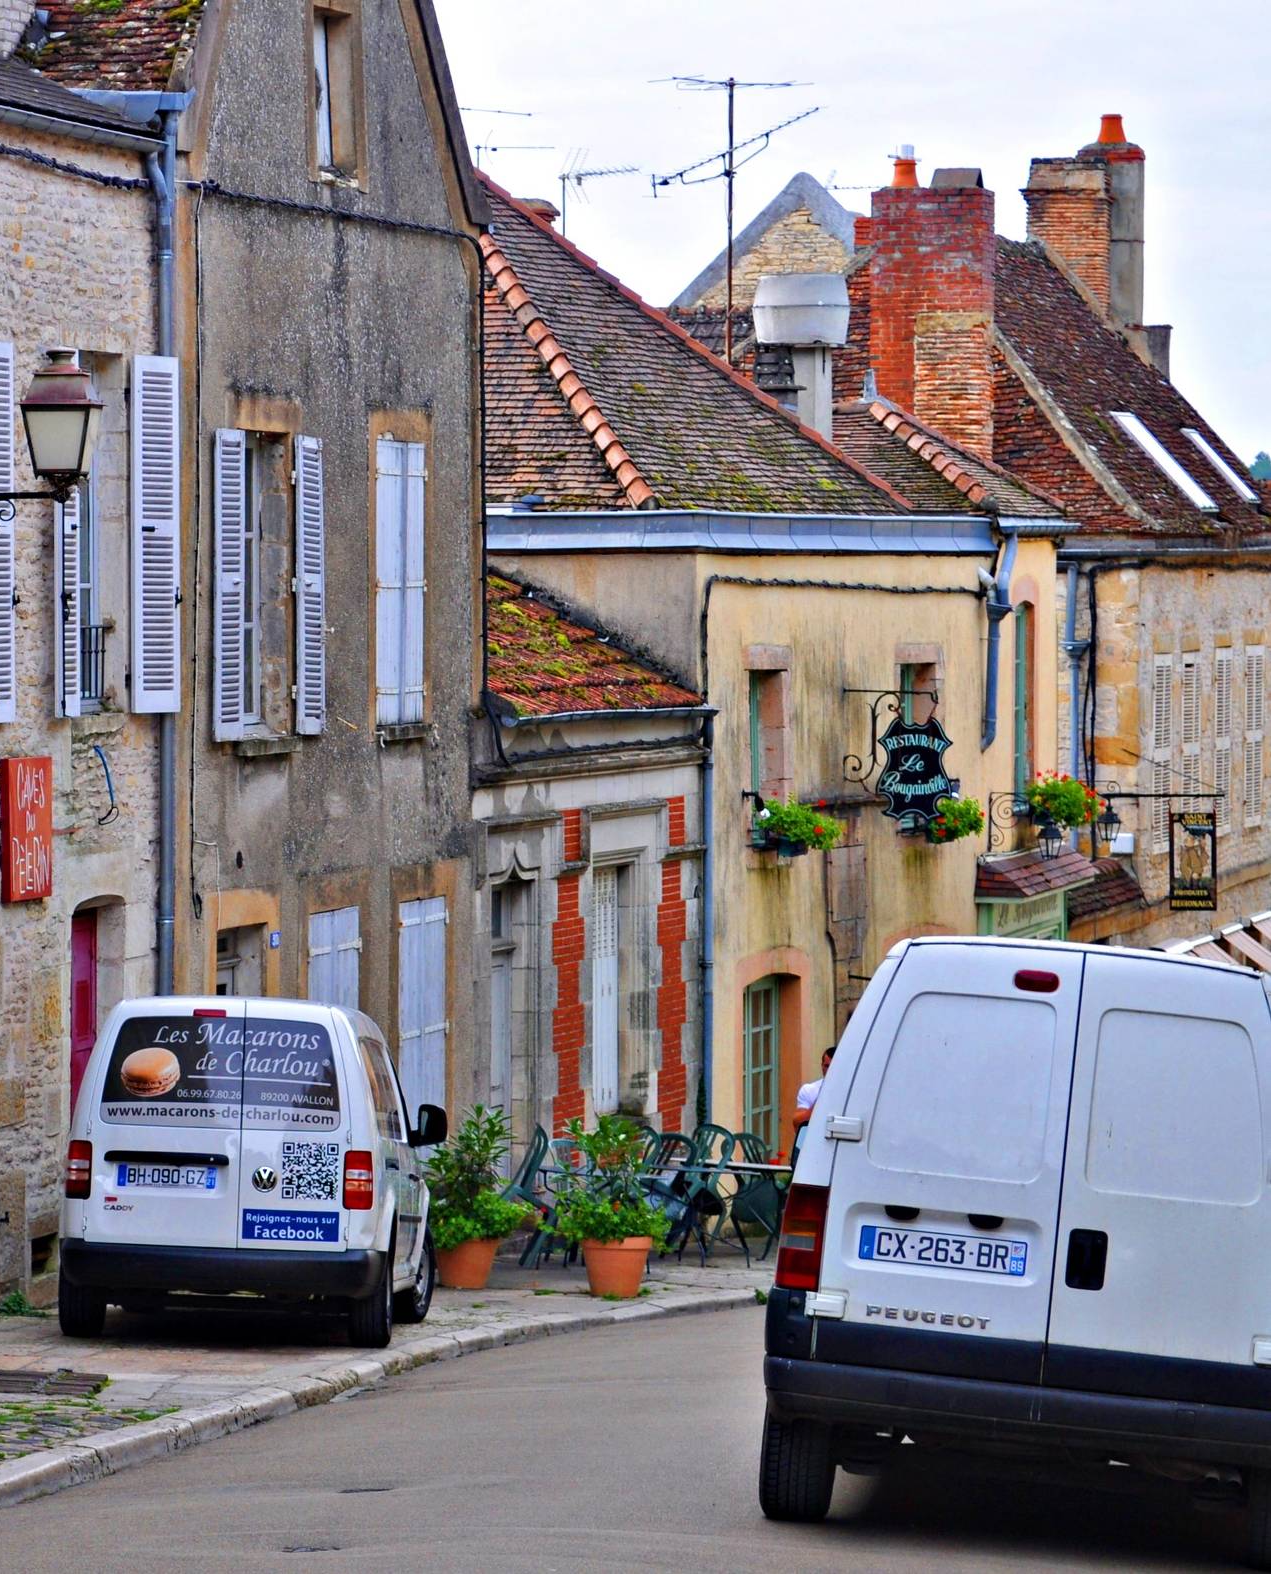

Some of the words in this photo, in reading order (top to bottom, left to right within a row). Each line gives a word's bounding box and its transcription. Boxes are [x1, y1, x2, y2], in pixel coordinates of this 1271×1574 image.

[886, 733, 947, 753] RESTAURANT
[898, 753, 925, 772] Le
[17, 763, 45, 810] CAVES
[879, 770, 948, 804] Bougainville
[26, 810, 36, 832] DU
[152, 1025, 190, 1045] Les
[195, 1022, 321, 1050] Macarons
[195, 1051, 218, 1071] de
[225, 1049, 319, 1077] Charlou
[176, 1087, 242, 1101] 06.99.67.80.26
[260, 1091, 289, 1102] 89200
[291, 1093, 334, 1106] AVALLON
[107, 1103, 335, 1126] www.macarons-de-charlou.com
[246, 1212, 319, 1225] Rejoignez-nous
[321, 1216, 337, 1225] sur
[254, 1225, 325, 1241] Facebook
[876, 1231, 1010, 1271] CX-263-BR
[1010, 1260, 1024, 1273] 89
[866, 1303, 992, 1331] PEUGEOT
